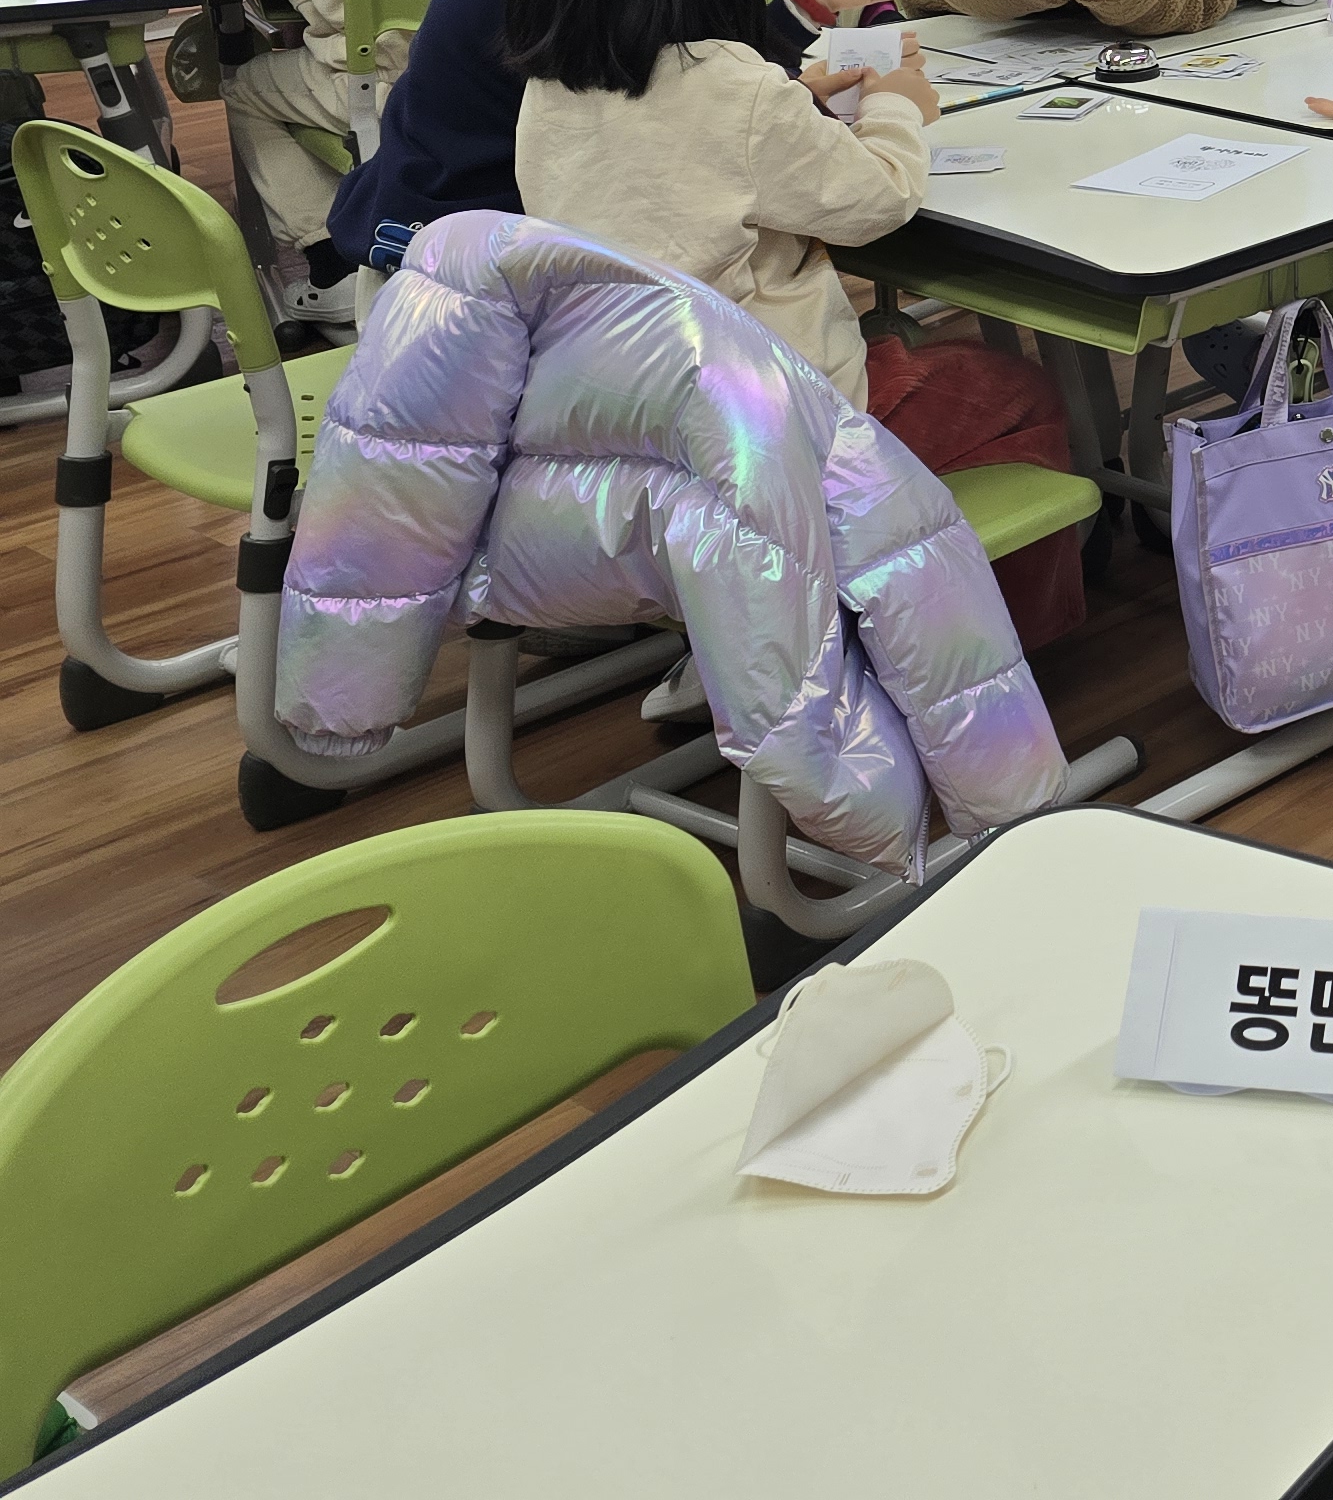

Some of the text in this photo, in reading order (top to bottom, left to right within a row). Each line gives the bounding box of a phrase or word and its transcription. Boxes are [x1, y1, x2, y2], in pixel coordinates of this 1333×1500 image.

[1290, 568, 1321, 591] NY
[1215, 584, 1244, 607] NY
[1255, 603, 1287, 627] NY
[1296, 619, 1326, 643] NY
[1261, 654, 1293, 678] NY
